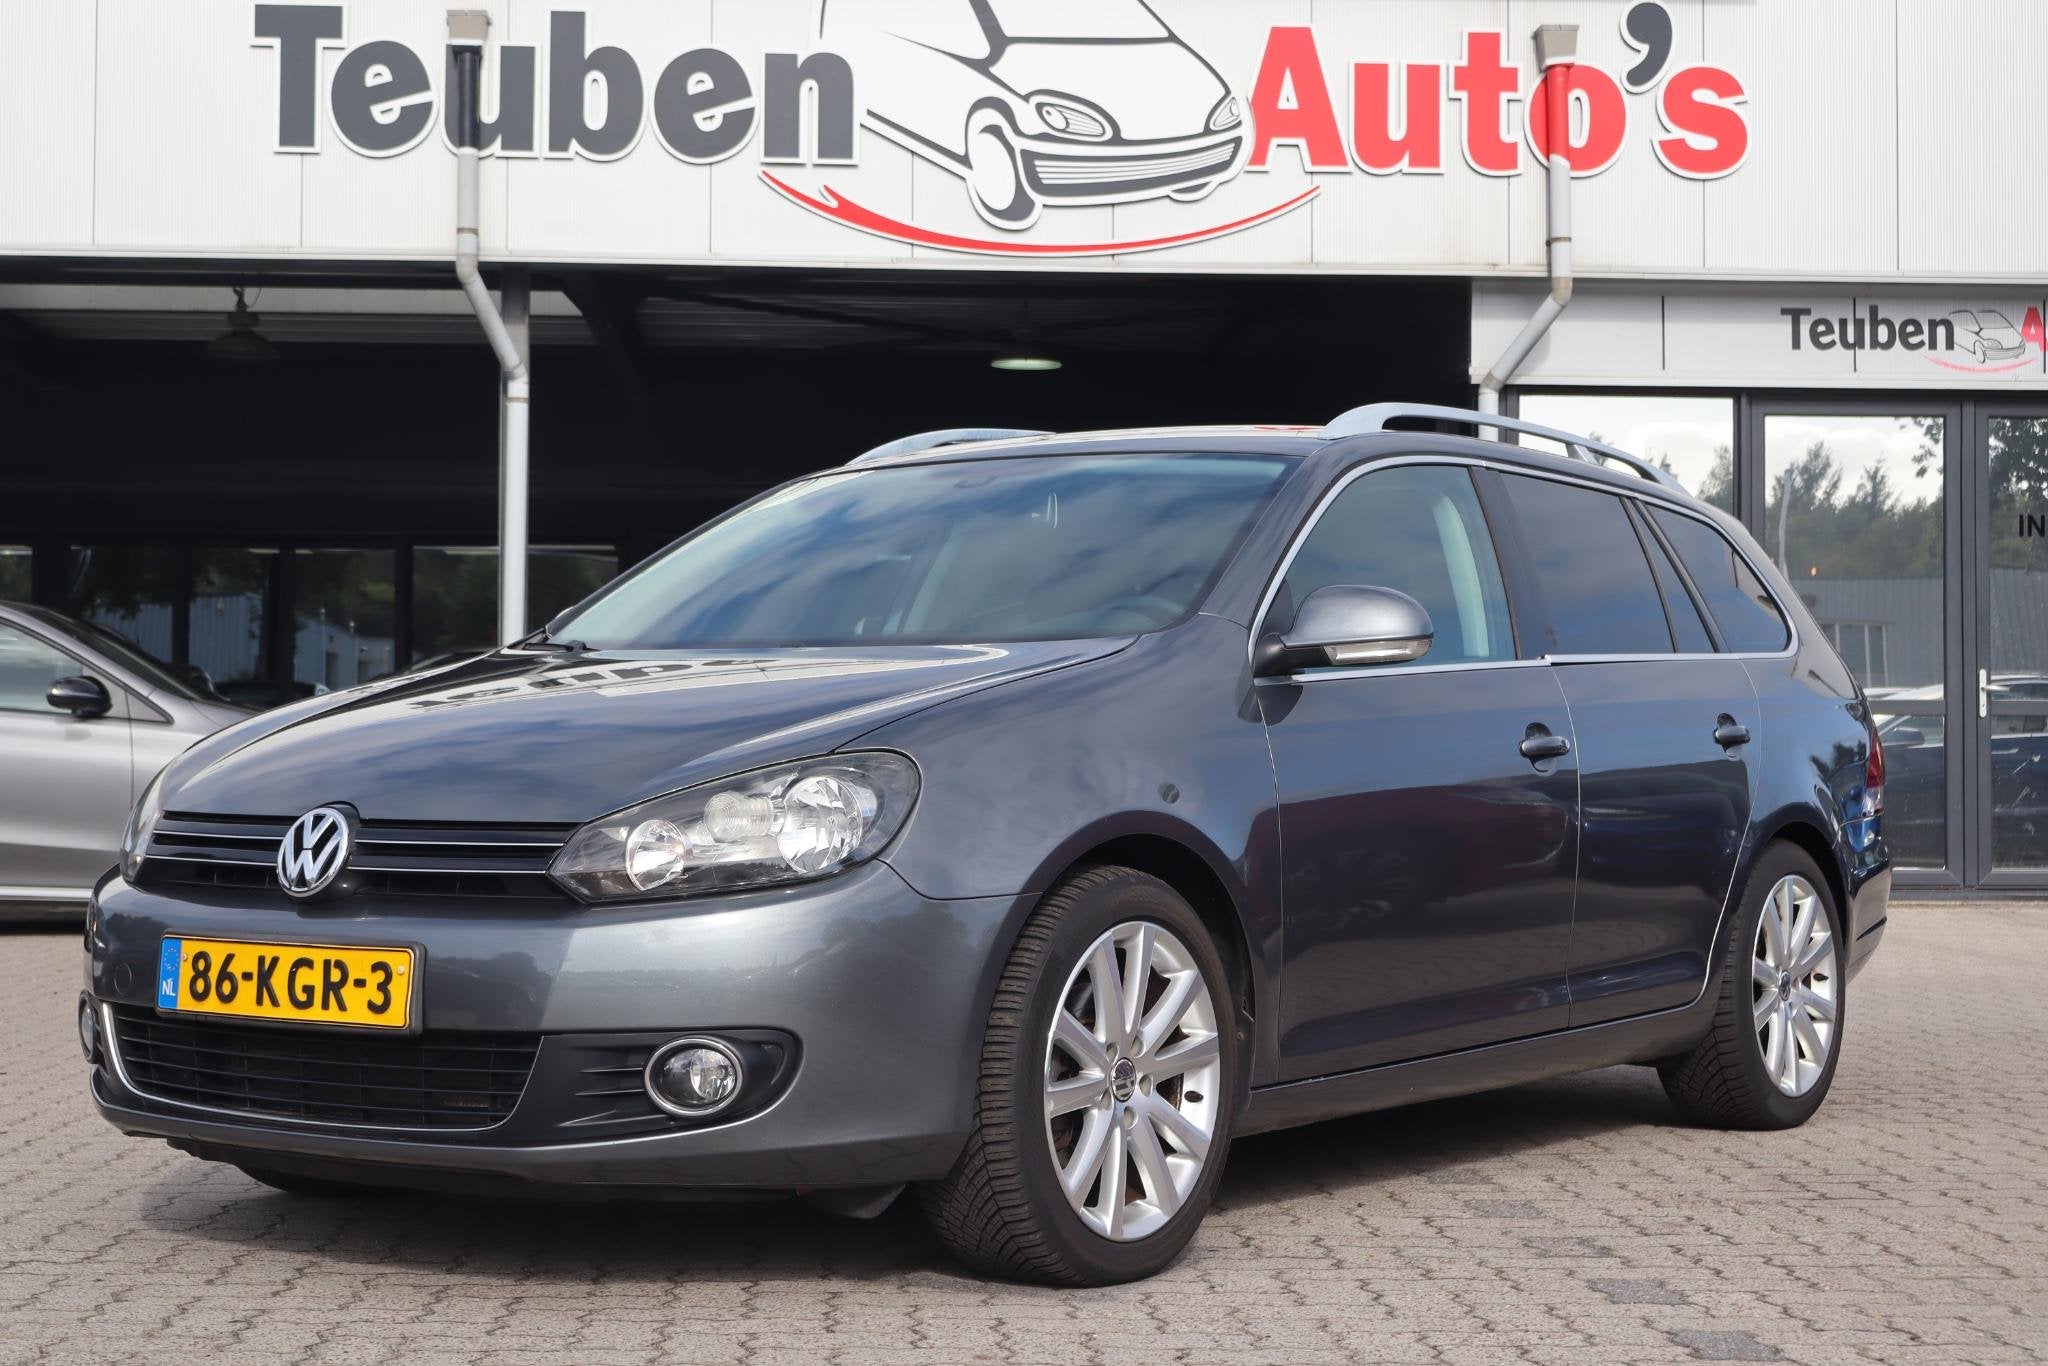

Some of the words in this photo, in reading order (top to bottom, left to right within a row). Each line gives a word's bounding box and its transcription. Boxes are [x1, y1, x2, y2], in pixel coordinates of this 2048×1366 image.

[254, 4, 855, 163] Teuben
[1248, 2, 1748, 175] Auto's
[1780, 305, 1955, 351] Teuben
[2019, 514, 2046, 537] IN
[162, 978, 176, 996] NL
[189, 951, 393, 1014] 86-KGR-3
